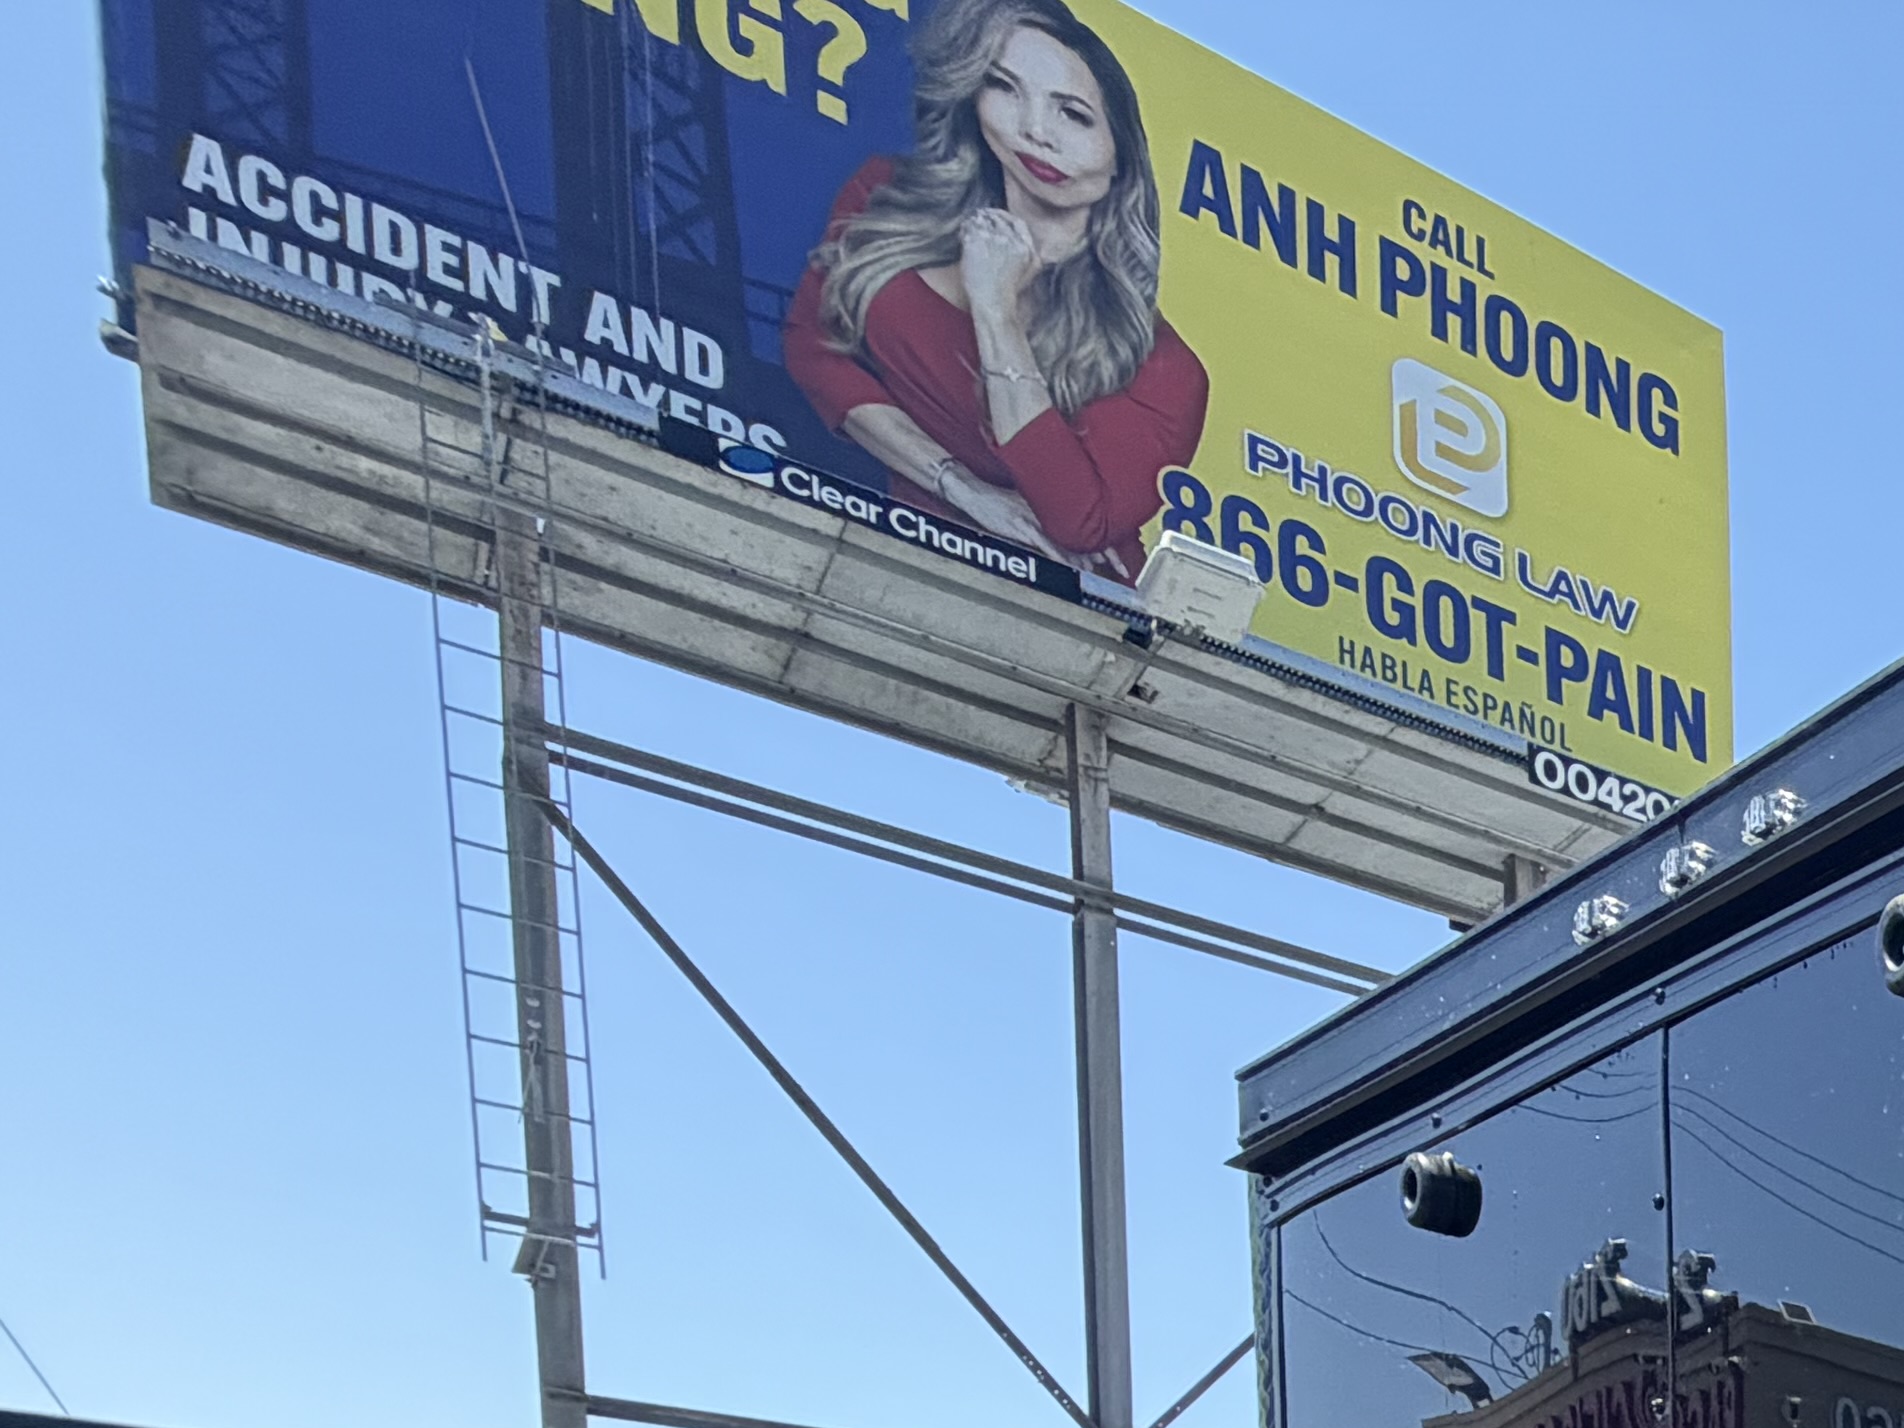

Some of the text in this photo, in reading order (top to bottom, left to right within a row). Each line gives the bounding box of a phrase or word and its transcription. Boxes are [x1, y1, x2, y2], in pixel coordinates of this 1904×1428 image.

[182, 133, 724, 390] ACCIDENT AND
[1179, 138, 1680, 457] ANH PHOONG
[1402, 200, 1495, 280] CALL
[781, 467, 1037, 583] Clear Channel
[1161, 469, 1707, 764] 866-GOT-PAIN
[1244, 429, 1639, 635] PHOONG LAW
[1338, 636, 1573, 752] HABLA ESPAÑOL
